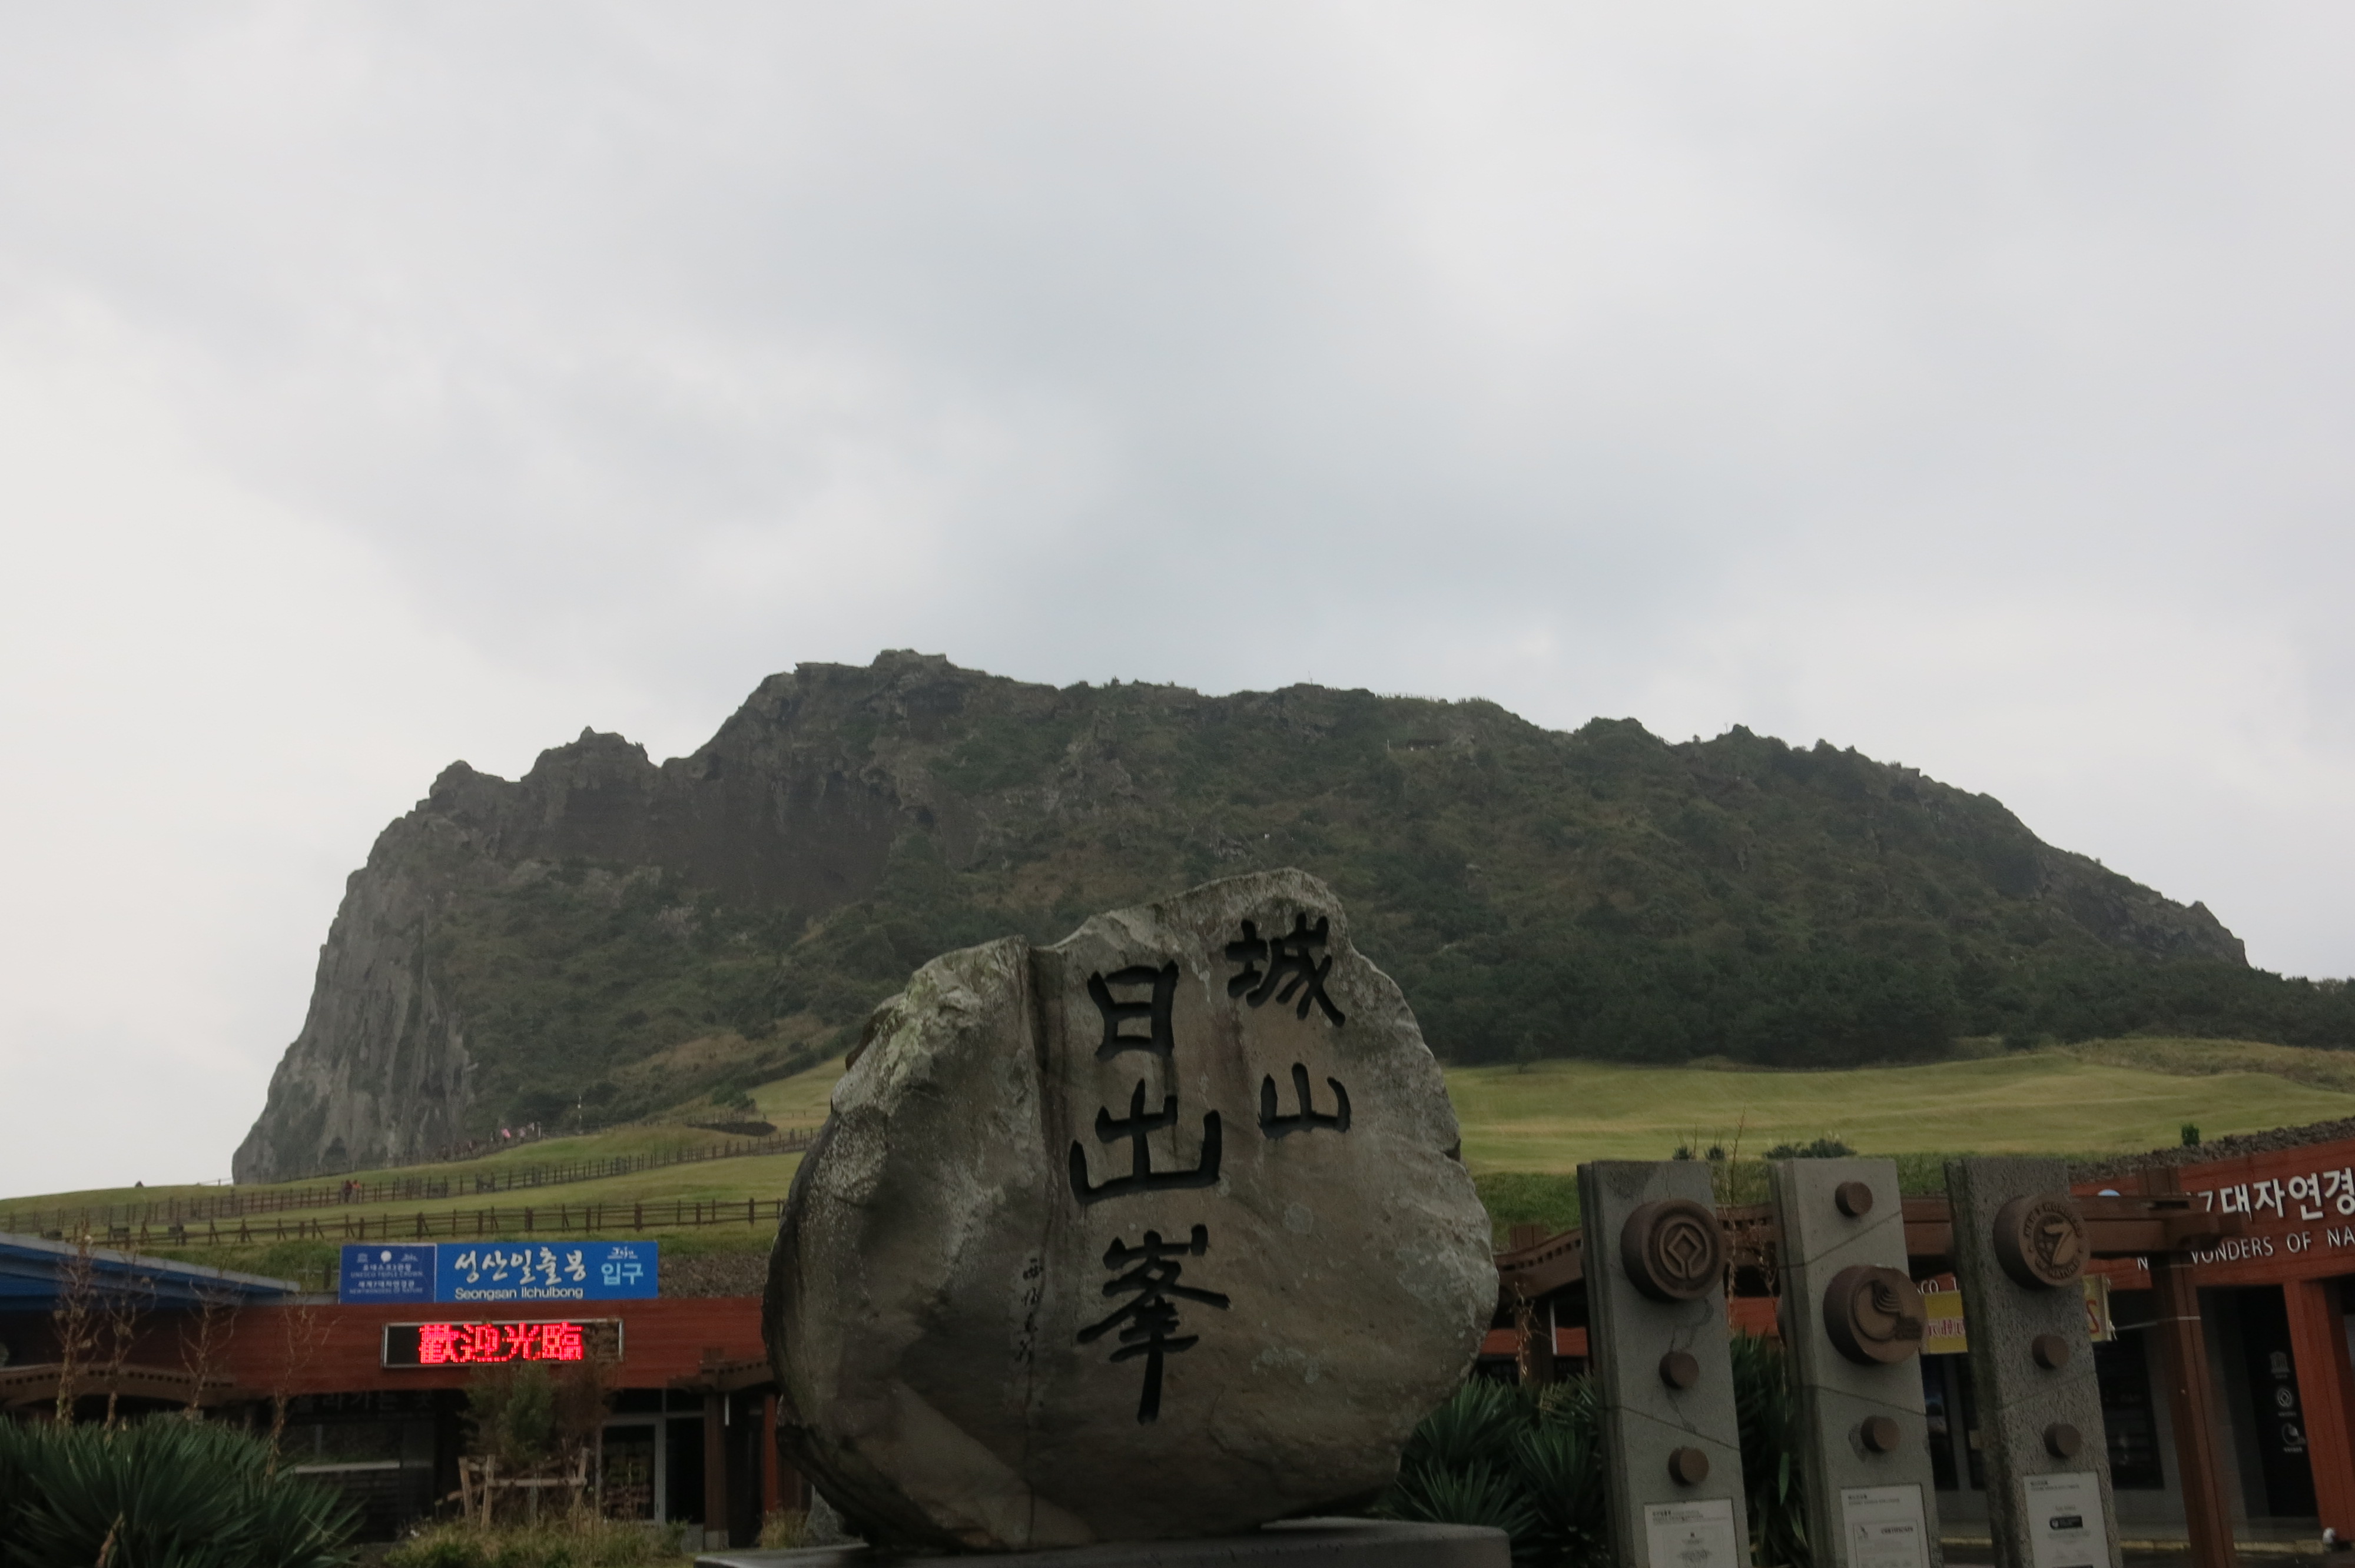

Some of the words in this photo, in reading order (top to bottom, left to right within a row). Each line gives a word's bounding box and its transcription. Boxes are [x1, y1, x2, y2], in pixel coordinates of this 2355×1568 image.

[1225, 912, 1352, 1140] 城山
[2286, 1231, 2312, 1253] OF
[455, 1247, 587, 1285] 성산일출봉
[601, 1262, 644, 1286] 입구
[455, 1287, 517, 1301] Seongsan
[521, 1287, 584, 1300] Ilchulbong
[419, 1321, 585, 1365] 歡迎光臨
